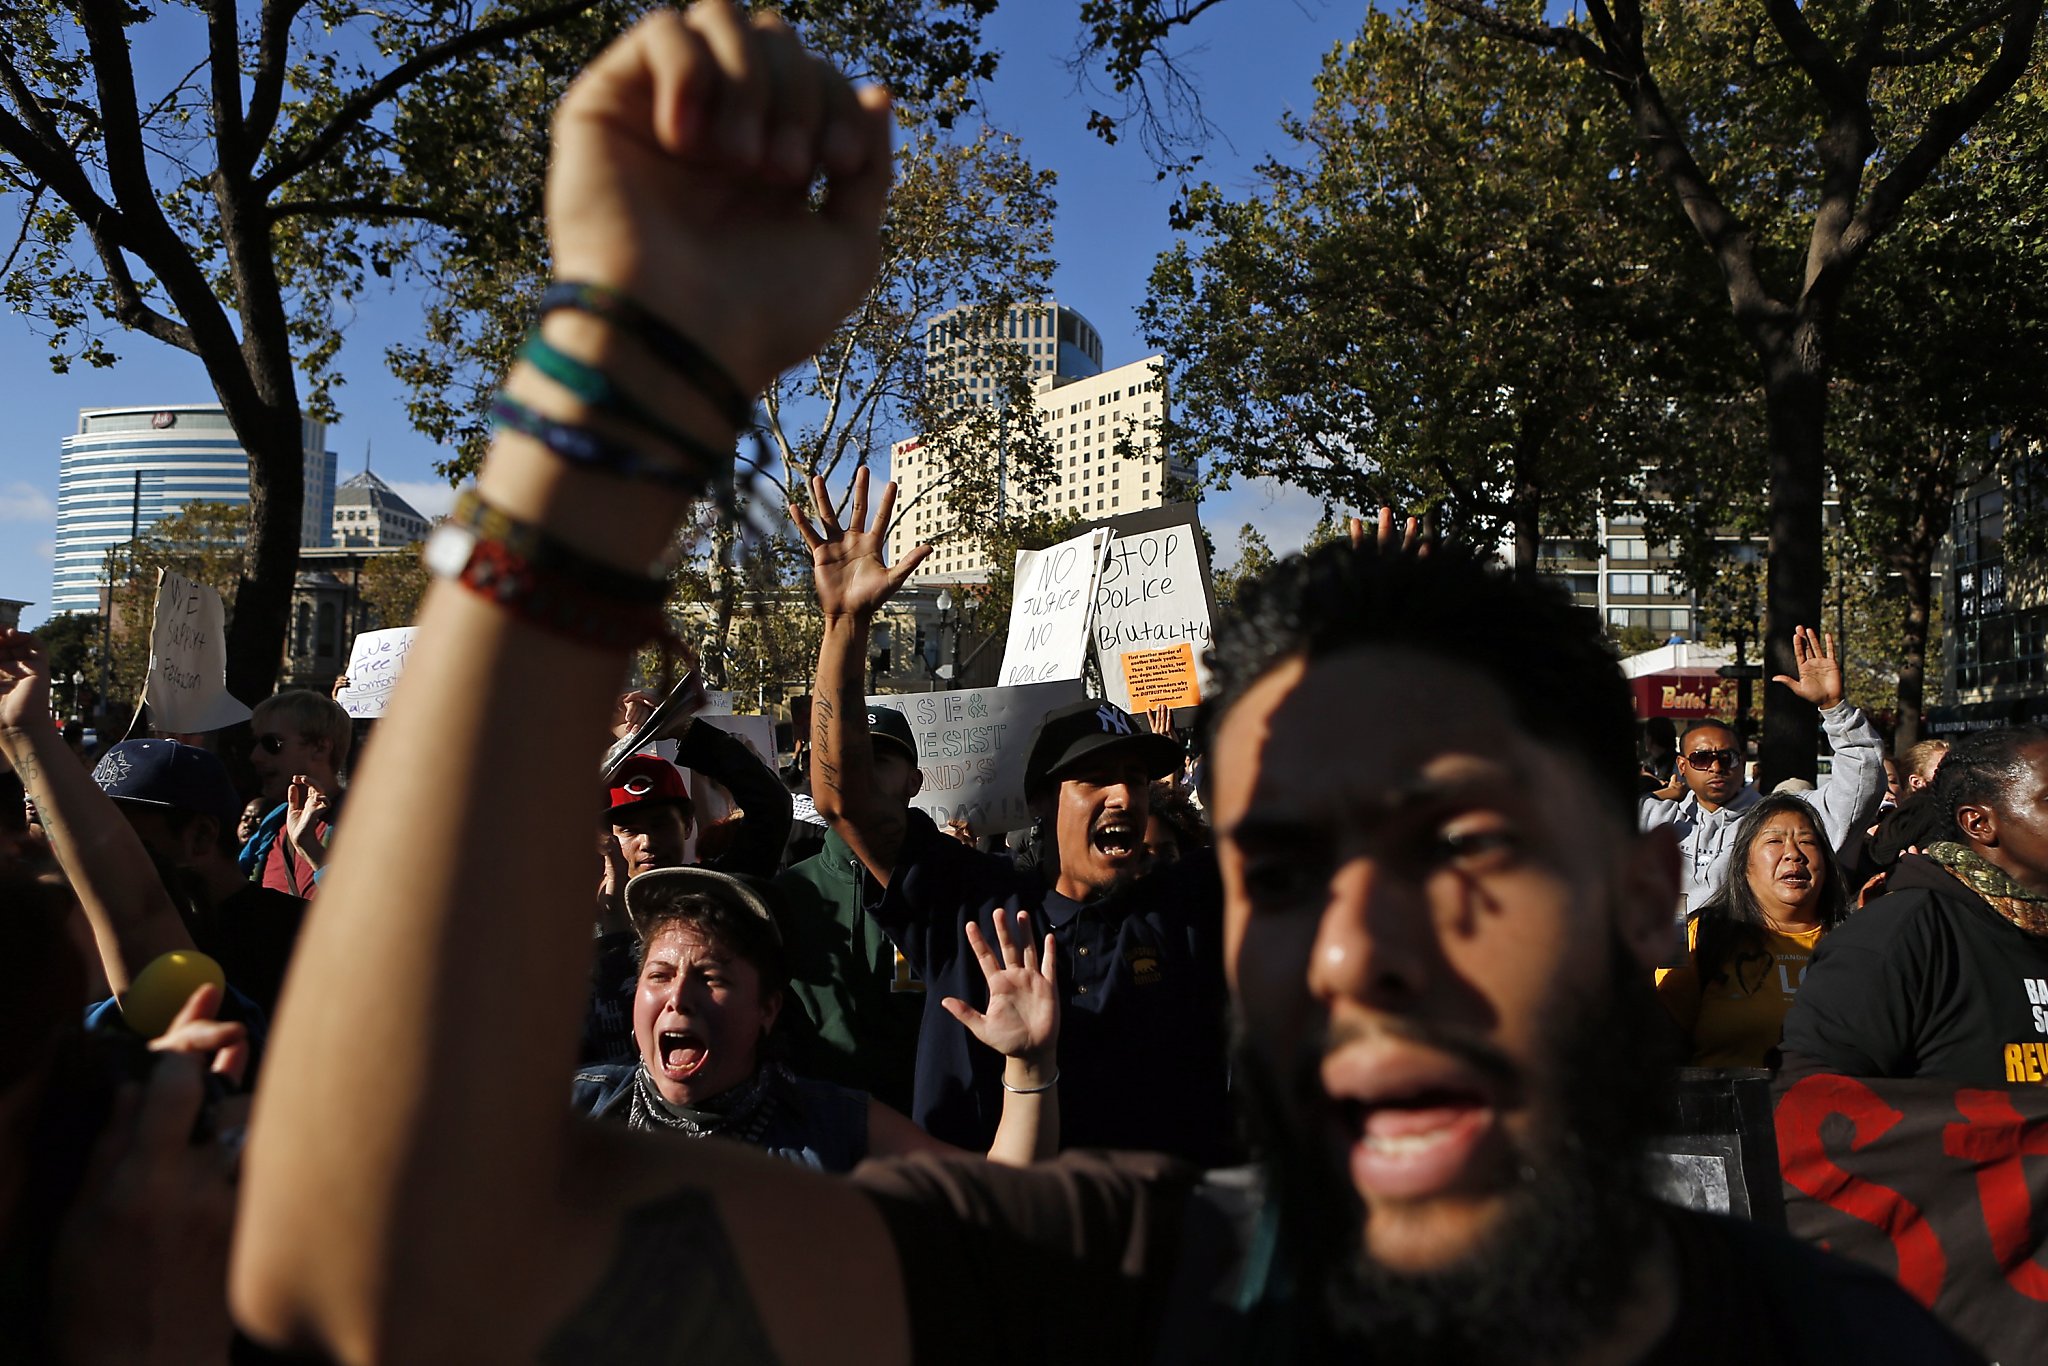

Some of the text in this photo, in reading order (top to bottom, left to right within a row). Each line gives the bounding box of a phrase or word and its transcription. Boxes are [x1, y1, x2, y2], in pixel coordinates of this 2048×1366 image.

[1037, 546, 1077, 592] NO
[1024, 622, 1053, 651] NO
[918, 724, 1007, 757] ESIST
[918, 758, 996, 792] ND'S
[918, 801, 992, 829] DAY
[1778, 964, 1807, 993] L
